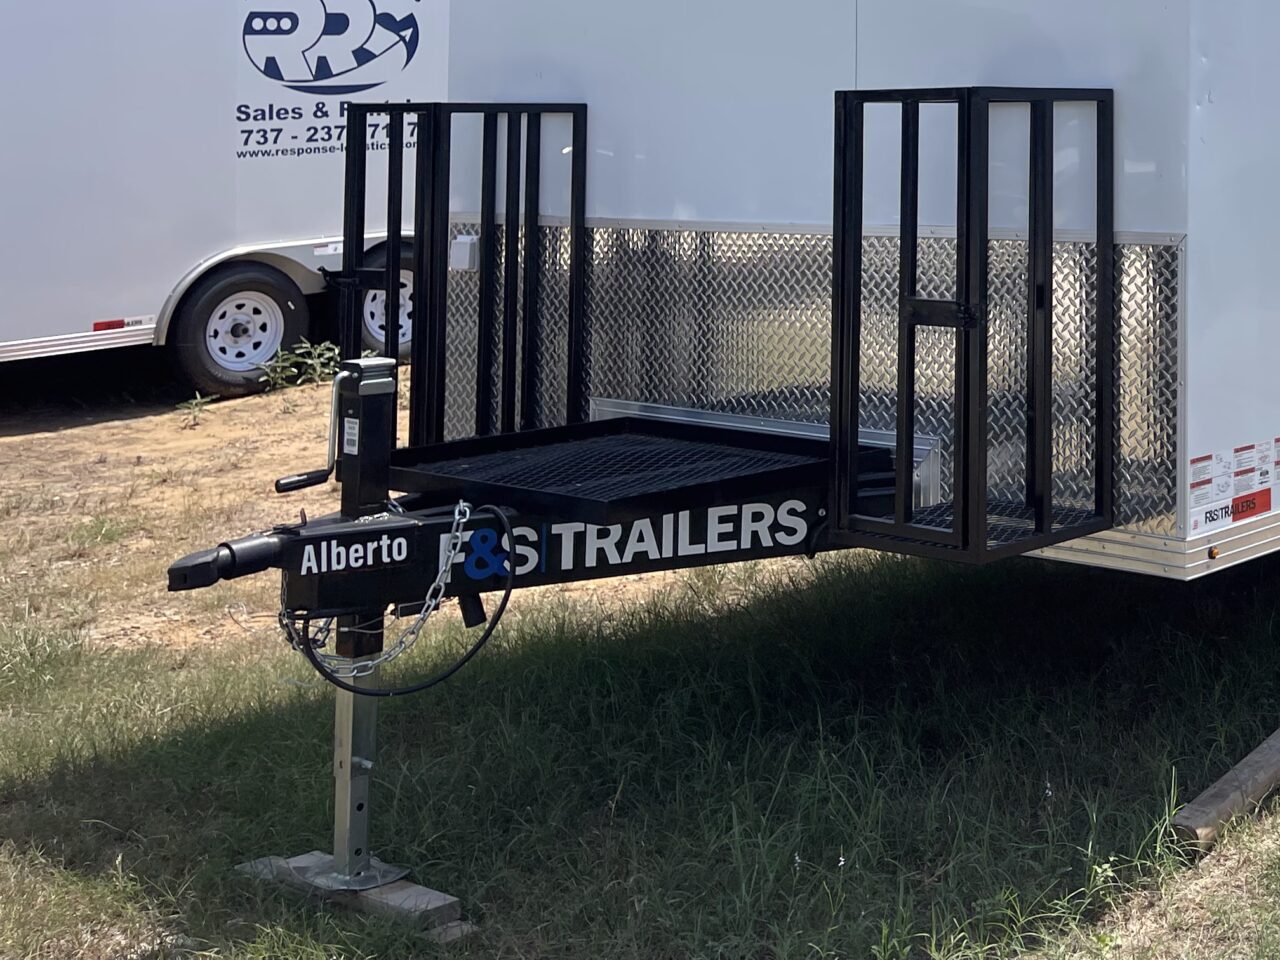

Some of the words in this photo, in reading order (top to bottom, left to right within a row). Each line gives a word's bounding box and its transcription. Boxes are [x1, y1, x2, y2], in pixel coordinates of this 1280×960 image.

[236, 104, 304, 122] Sales
[313, 101, 330, 119] &
[240, 127, 284, 146] 737
[305, 125, 347, 143] 237
[368, 122, 418, 140] 717
[1219, 497, 1257, 520] TRAILERS
[439, 526, 539, 584] F&S
[551, 499, 808, 571] TRAILERS
[301, 534, 408, 576] Alberto
